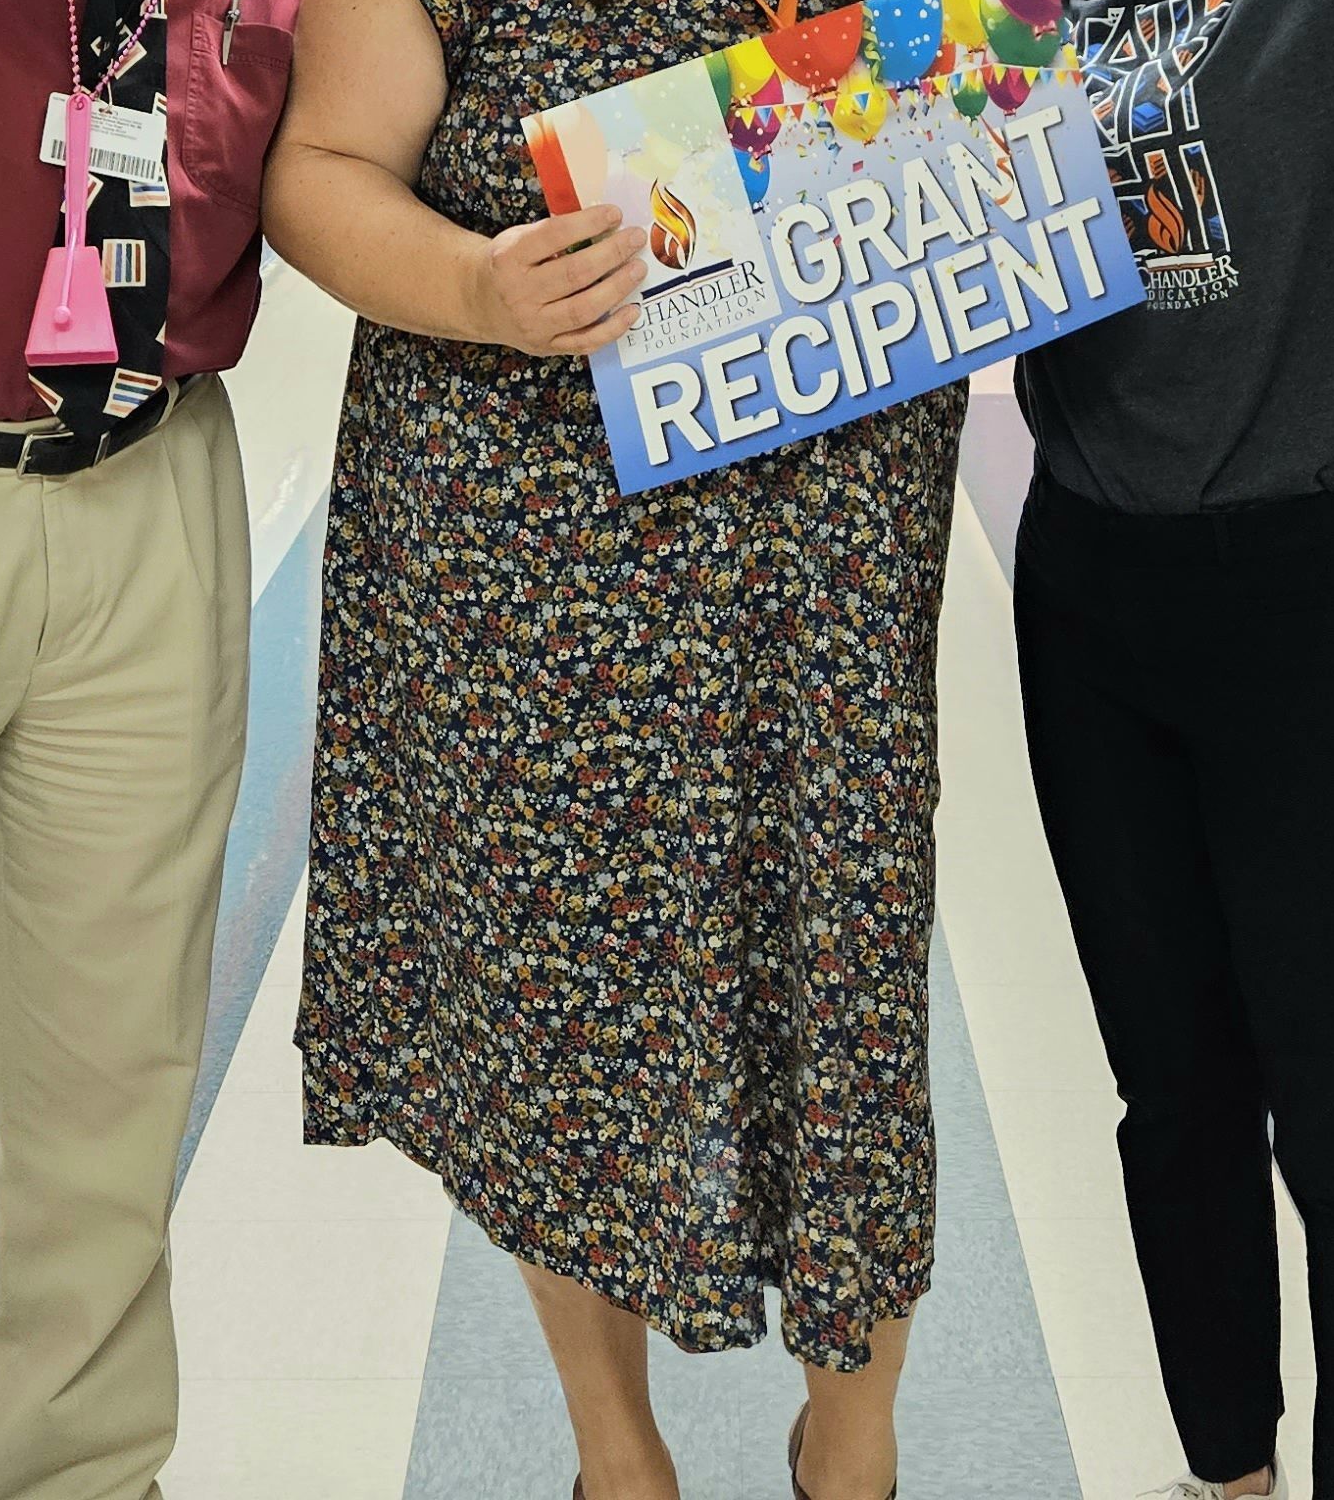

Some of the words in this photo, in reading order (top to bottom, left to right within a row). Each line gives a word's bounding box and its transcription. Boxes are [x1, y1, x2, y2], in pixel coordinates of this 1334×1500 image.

[771, 105, 1067, 304] GRANT
[1146, 289, 1230, 311] FOUNDATION
[1148, 275, 1240, 301] DUCATION
[627, 287, 767, 347] EDUCATION
[630, 197, 1106, 466] RECIPIENT
[644, 307, 757, 354] FOUNDATION
